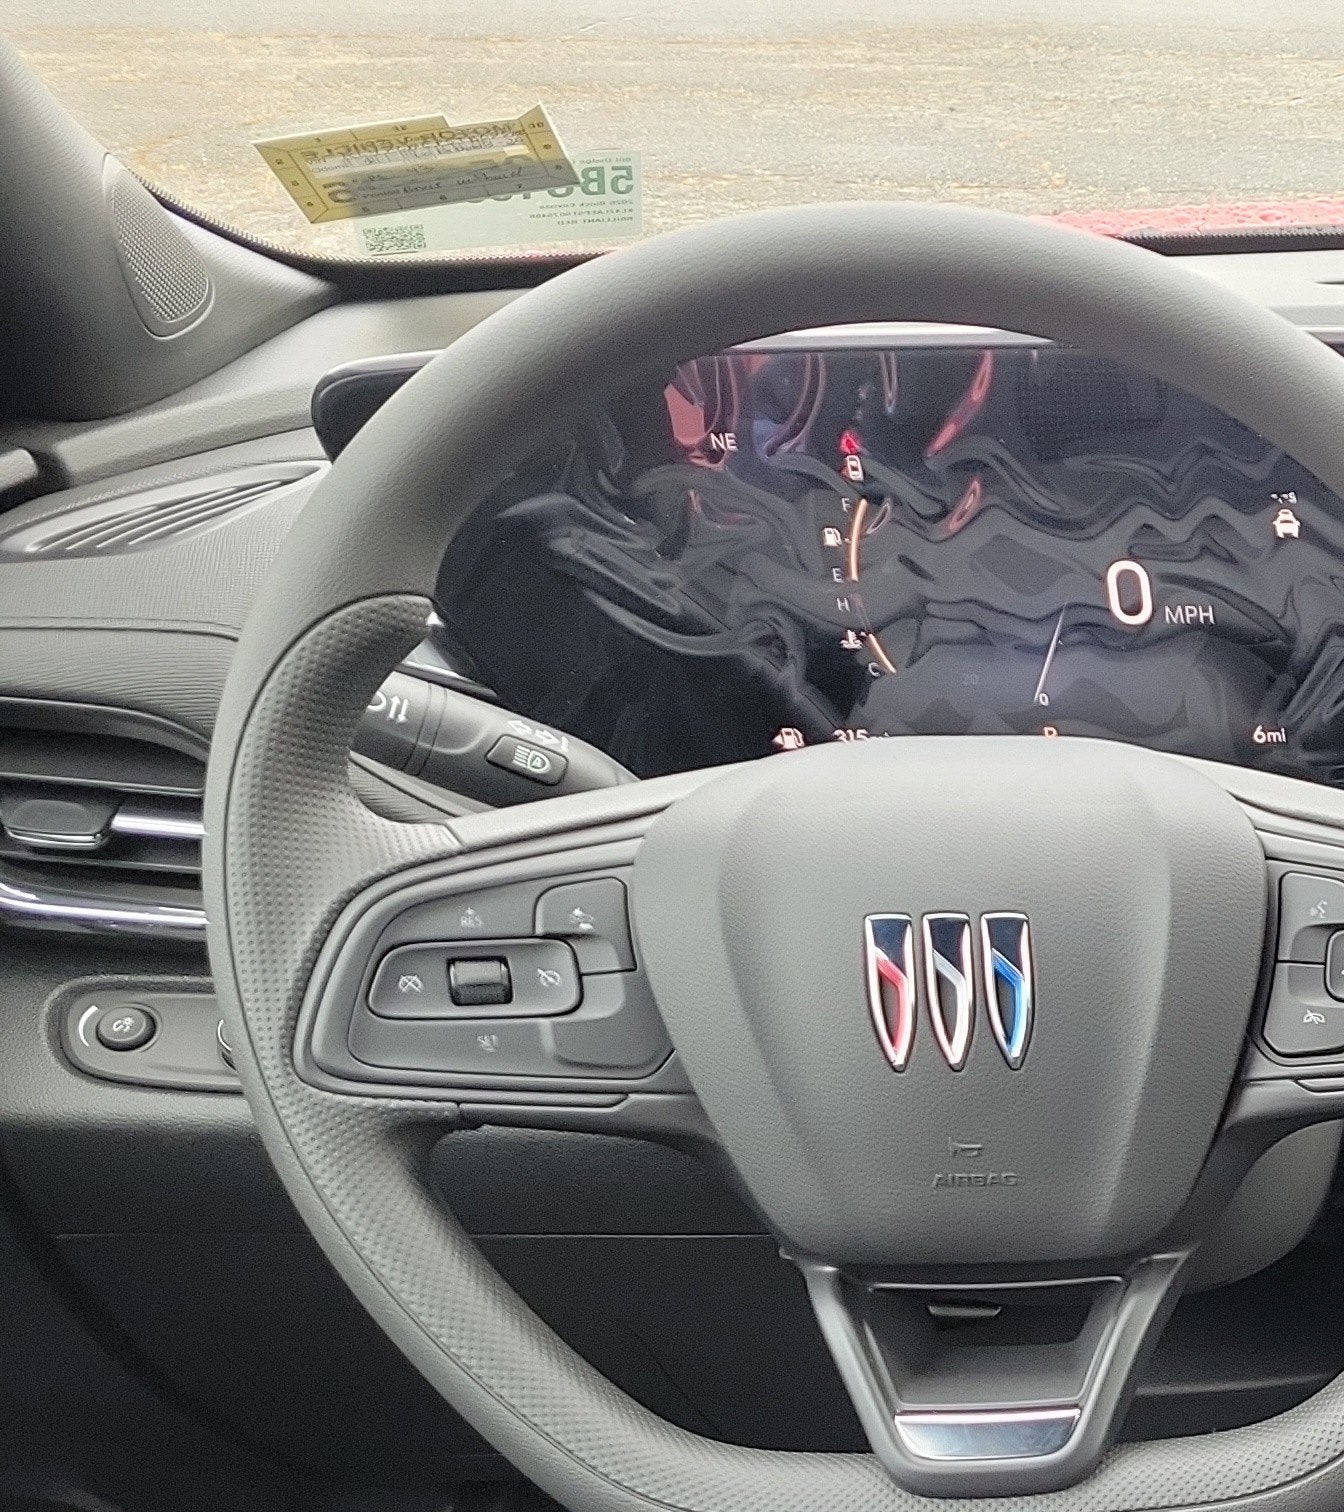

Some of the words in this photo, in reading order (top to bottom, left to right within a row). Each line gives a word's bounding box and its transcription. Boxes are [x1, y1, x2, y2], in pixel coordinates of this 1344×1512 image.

[710, 432, 739, 451] NE
[841, 498, 851, 513] F
[832, 567, 845, 584] E
[1106, 559, 1153, 626] 0
[1163, 604, 1216, 626] MPH
[836, 597, 851, 613] H
[868, 661, 882, 678] C
[1252, 724, 1287, 743] 6mi
